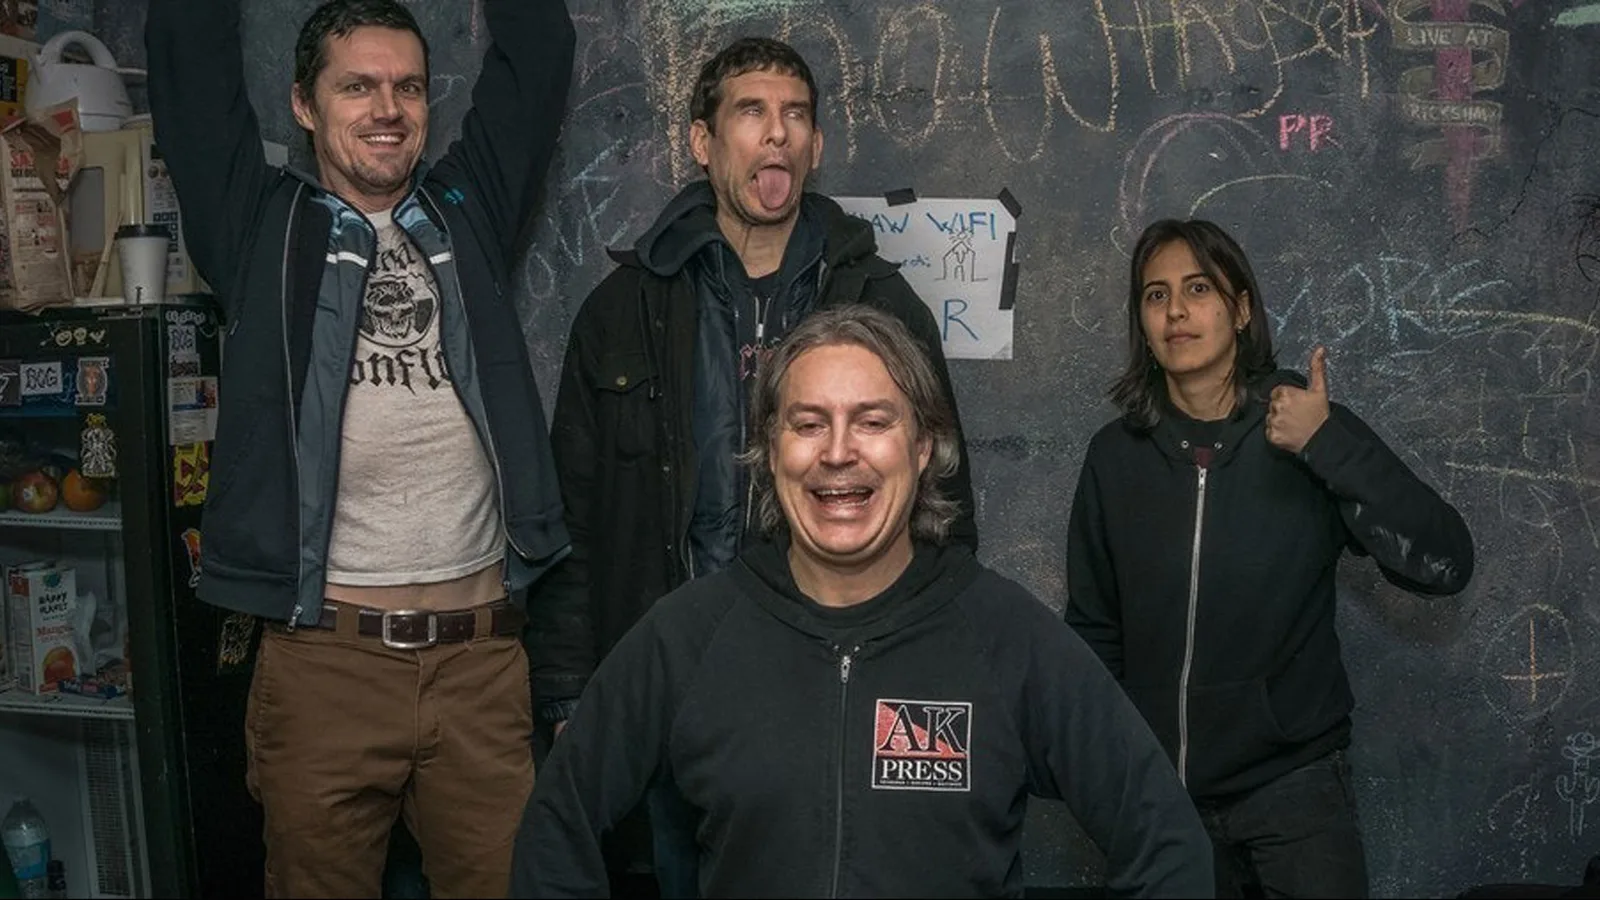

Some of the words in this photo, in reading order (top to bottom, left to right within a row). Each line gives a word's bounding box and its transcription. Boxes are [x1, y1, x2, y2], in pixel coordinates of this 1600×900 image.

[1406, 27, 1451, 46] LIVE
[1464, 27, 1493, 46] AT
[926, 212, 996, 240] WIFI
[876, 704, 968, 753] AK
[880, 759, 964, 781] PRESS
